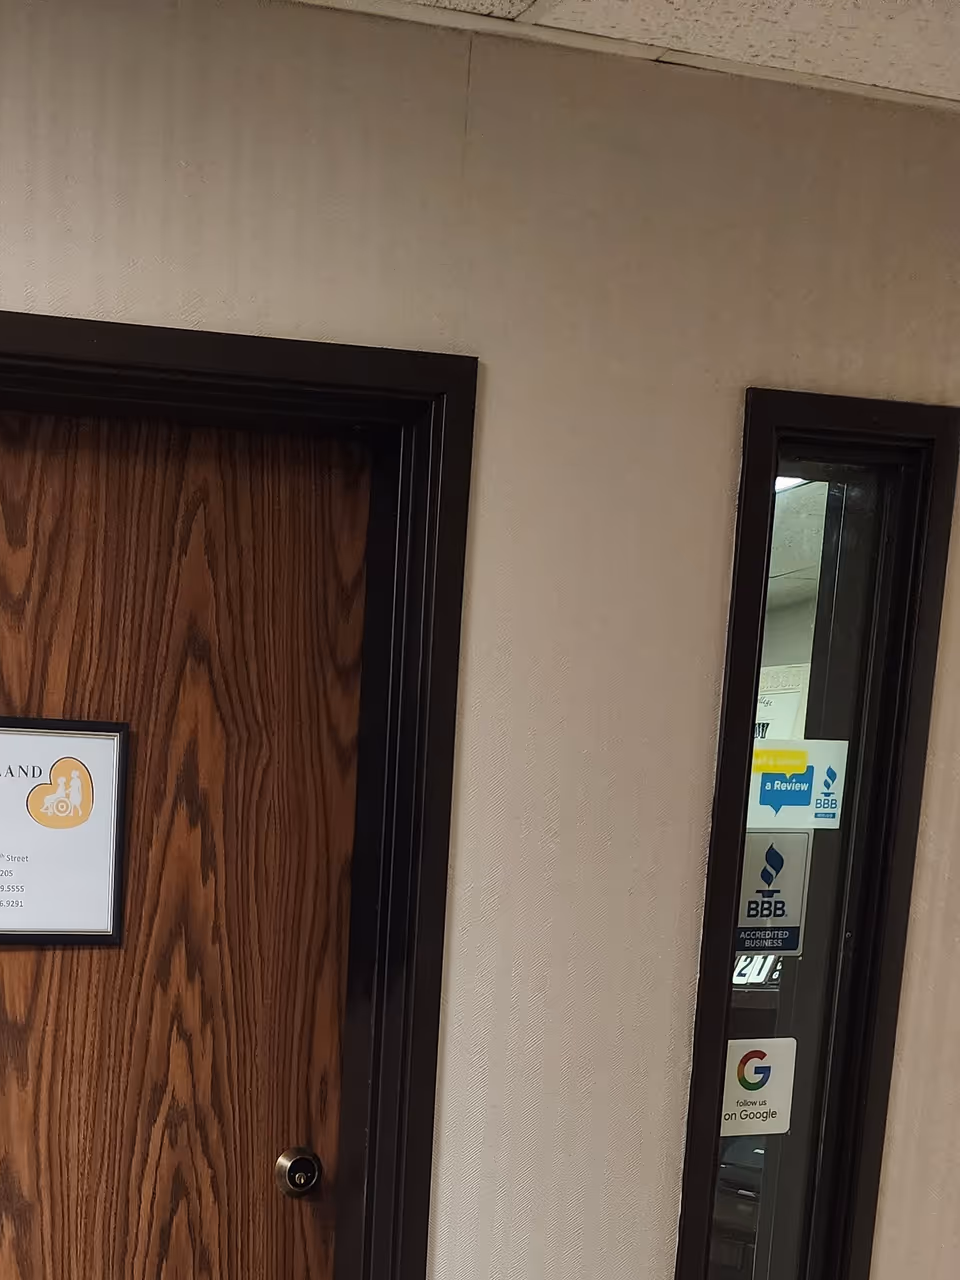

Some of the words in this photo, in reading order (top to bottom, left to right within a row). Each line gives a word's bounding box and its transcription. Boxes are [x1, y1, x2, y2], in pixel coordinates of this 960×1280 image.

[765, 782, 771, 790] a
[774, 778, 809, 791] Review
[815, 798, 837, 809] BBB
[6, 854, 29, 862] Street
[0, 869, 14, 877] 205
[746, 900, 786, 918] BBB
[740, 930, 789, 939] ACCREDITED
[745, 939, 783, 947] BUSINESS
[736, 1099, 758, 1107] follow
[724, 1112, 737, 1121] on
[739, 1108, 778, 1122] Google
